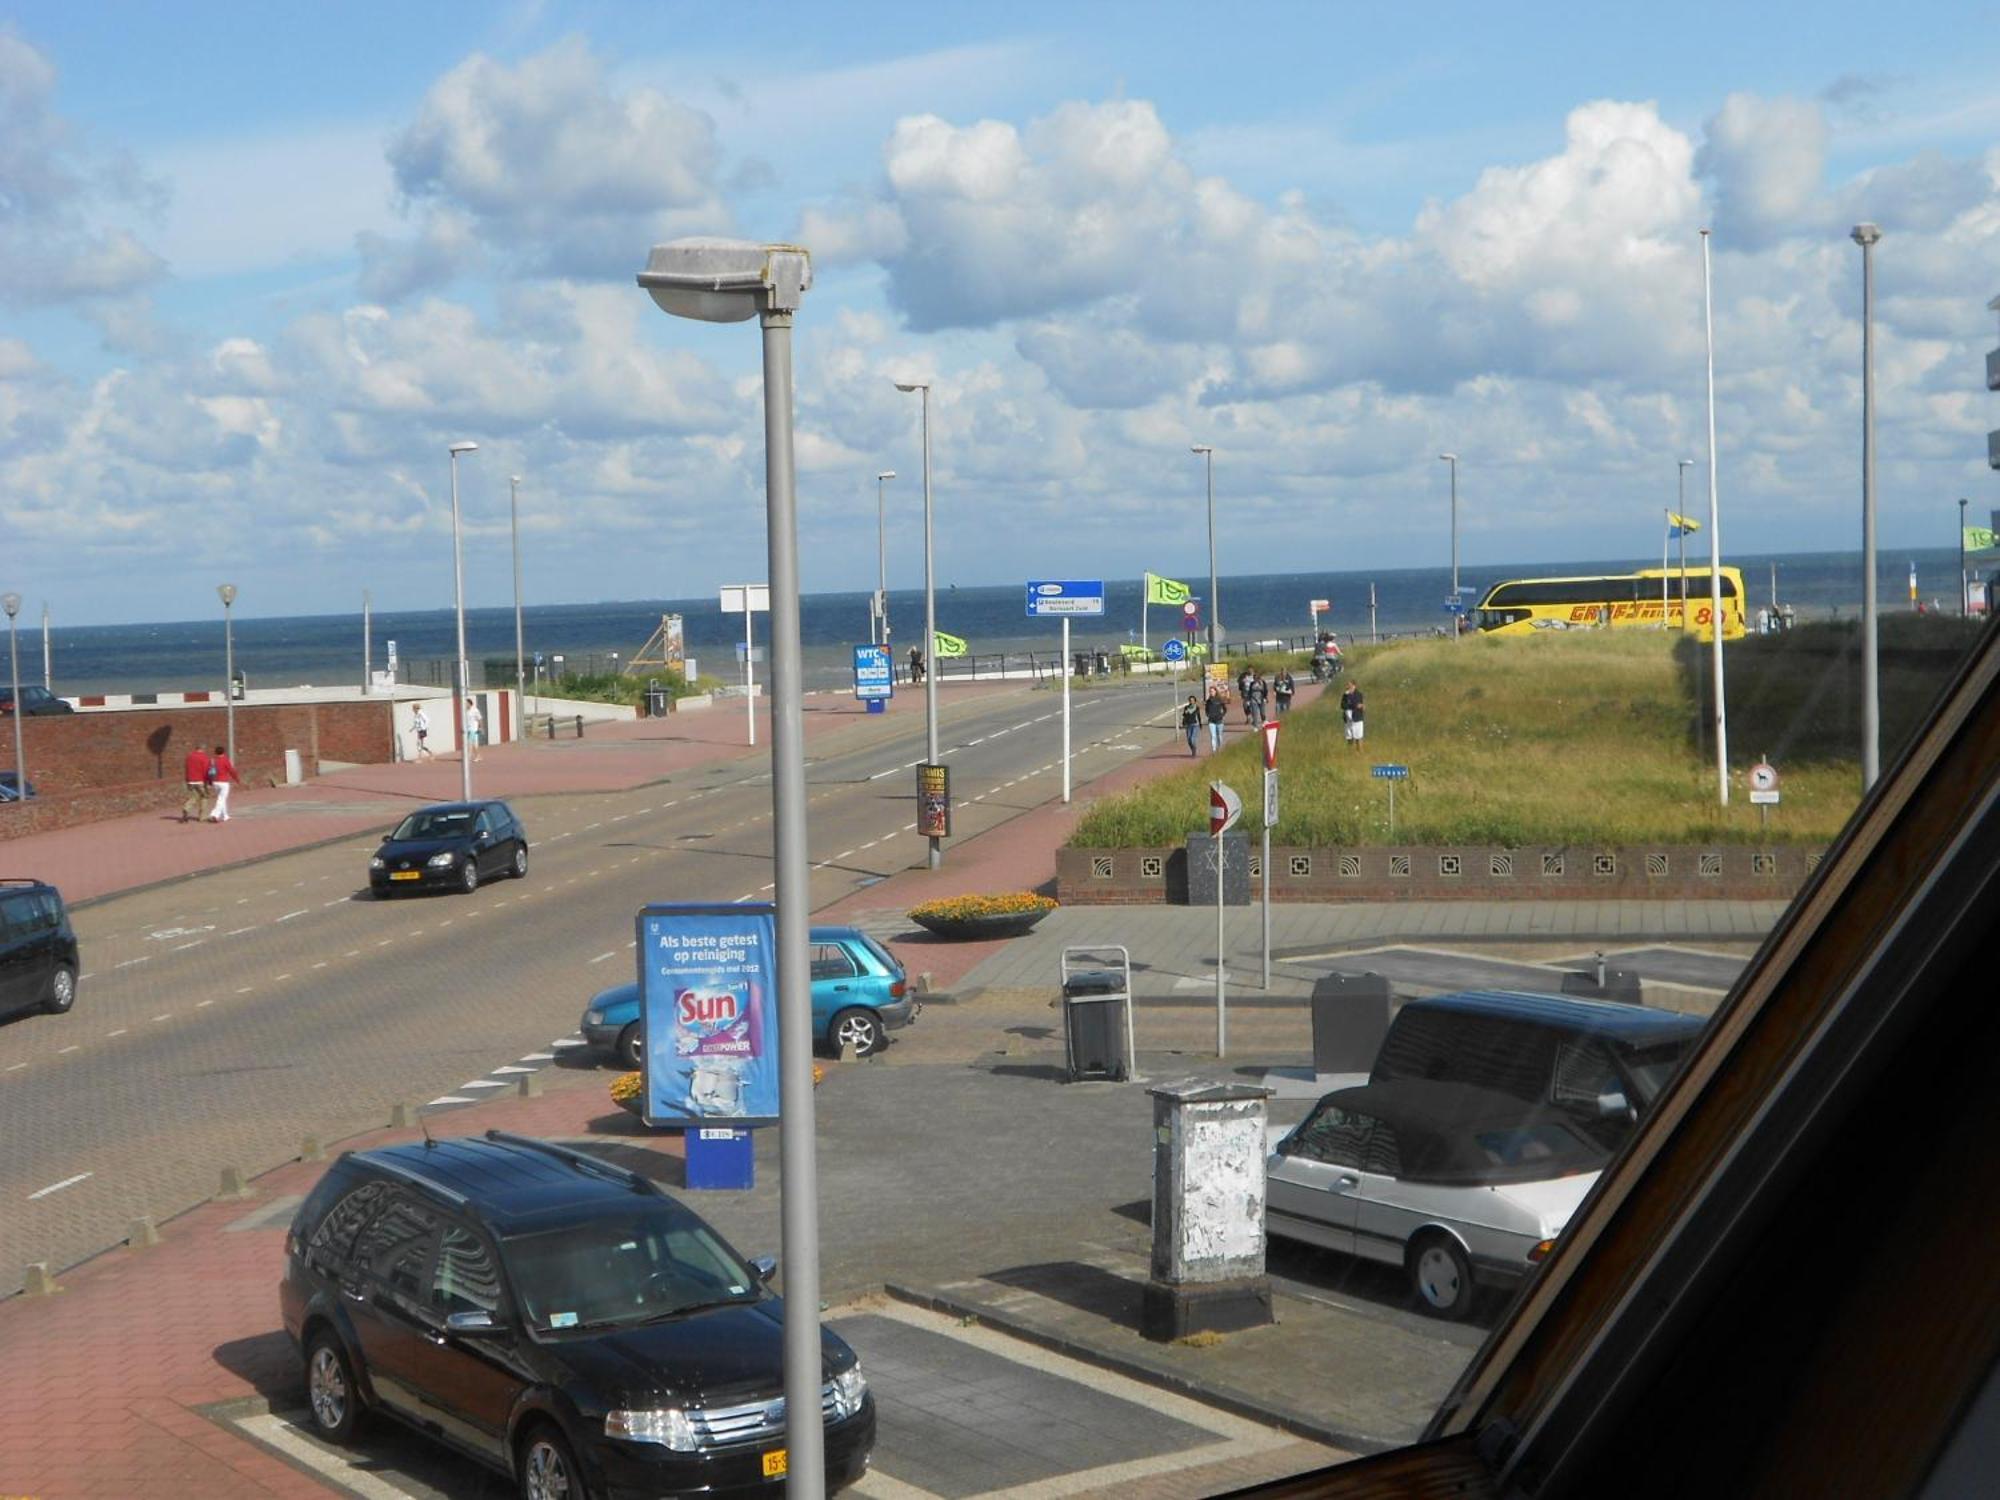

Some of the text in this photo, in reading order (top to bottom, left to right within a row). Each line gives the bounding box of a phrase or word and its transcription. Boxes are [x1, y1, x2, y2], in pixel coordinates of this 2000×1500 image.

[856, 648, 880, 659] WTC
[660, 934, 758, 949] Als beste getest
[674, 948, 746, 964] op reiniging
[680, 993, 736, 1022] Sun
